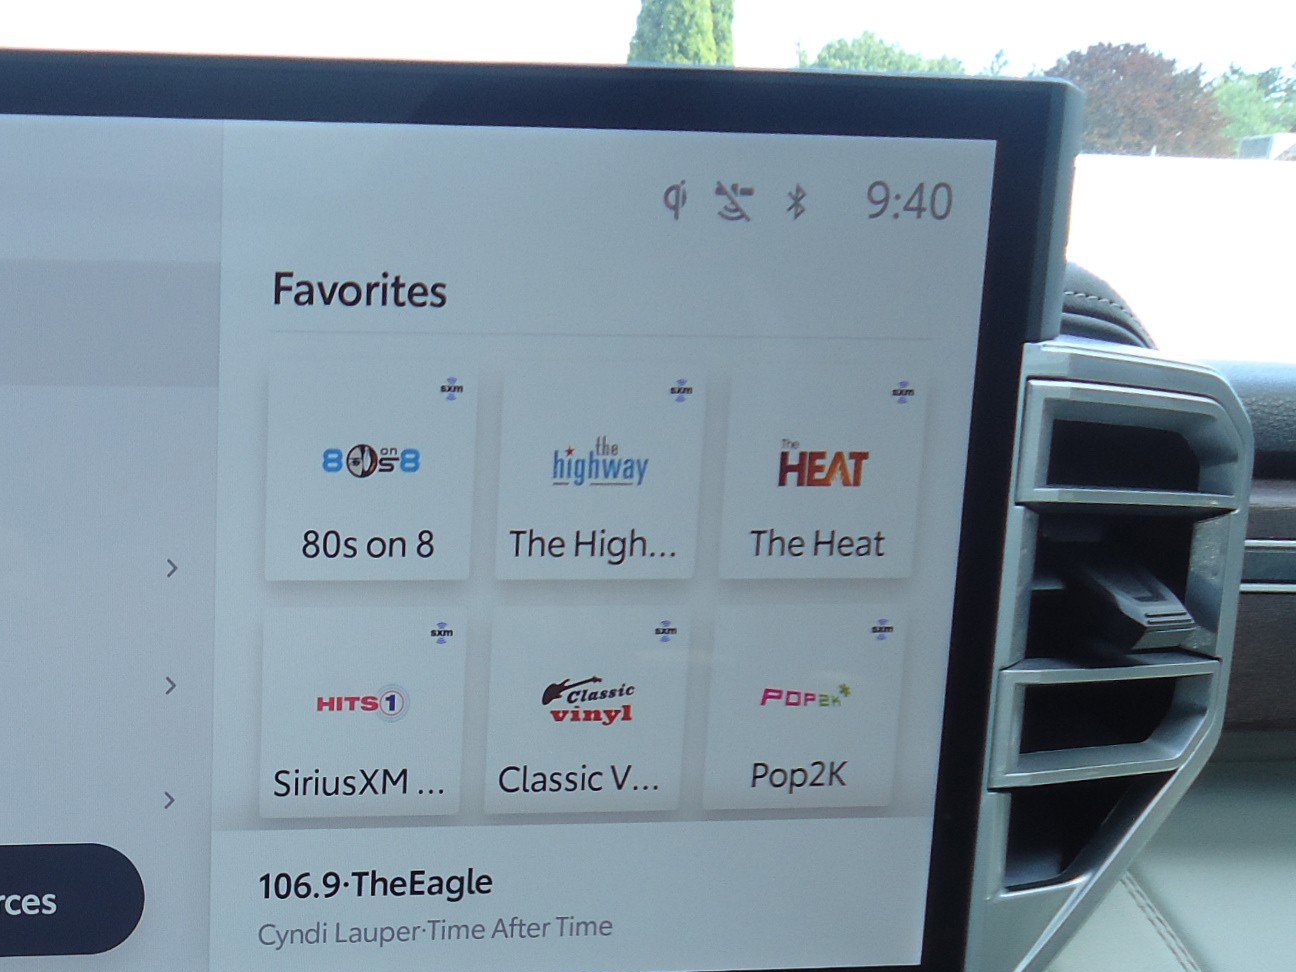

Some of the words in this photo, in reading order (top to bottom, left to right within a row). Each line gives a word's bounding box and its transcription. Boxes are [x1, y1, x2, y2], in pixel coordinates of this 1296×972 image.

[866, 181, 953, 220] 9:40
[273, 272, 448, 308] Favorites
[596, 436, 618, 455] the
[553, 449, 649, 486] highway
[777, 451, 870, 487] HEAT
[301, 530, 357, 558] 80s
[366, 536, 406, 557] on
[416, 530, 434, 557] 8
[509, 529, 565, 557] The
[574, 529, 677, 565] High...
[750, 529, 805, 557] The
[813, 530, 885, 557] Heat
[430, 629, 453, 637] sxm
[317, 696, 379, 711] HITS
[567, 683, 635, 704] Classic
[550, 705, 633, 726] vinyl
[273, 768, 408, 797] SiriusXM
[499, 764, 604, 793] Classic
[751, 760, 848, 794] Pop2K
[258, 922, 327, 950] Cyndi
[491, 917, 551, 939] After
[556, 915, 614, 938] Time
